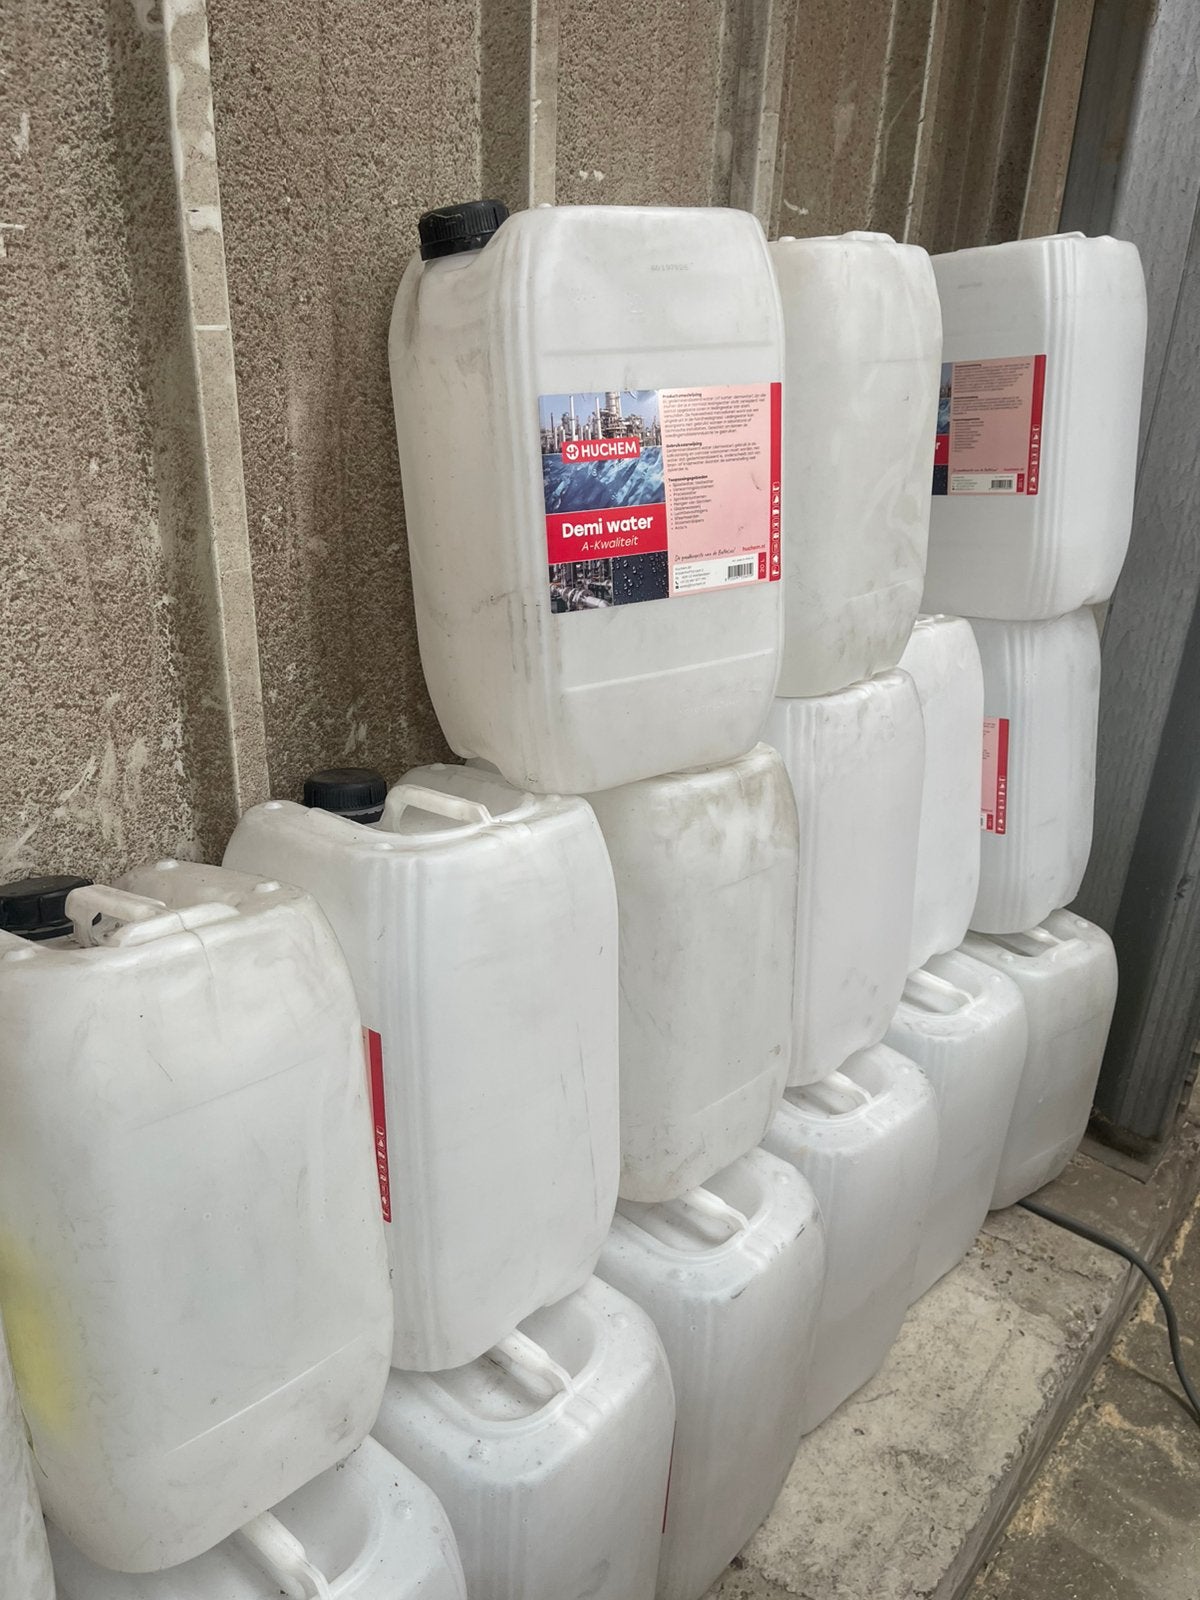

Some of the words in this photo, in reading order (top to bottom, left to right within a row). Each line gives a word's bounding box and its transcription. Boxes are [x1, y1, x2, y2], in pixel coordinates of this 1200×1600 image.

[581, 441, 637, 458] HUCHEM
[562, 518, 603, 538] Demi
[606, 516, 654, 534] water
[581, 535, 639, 552] A-Kwaliteit
